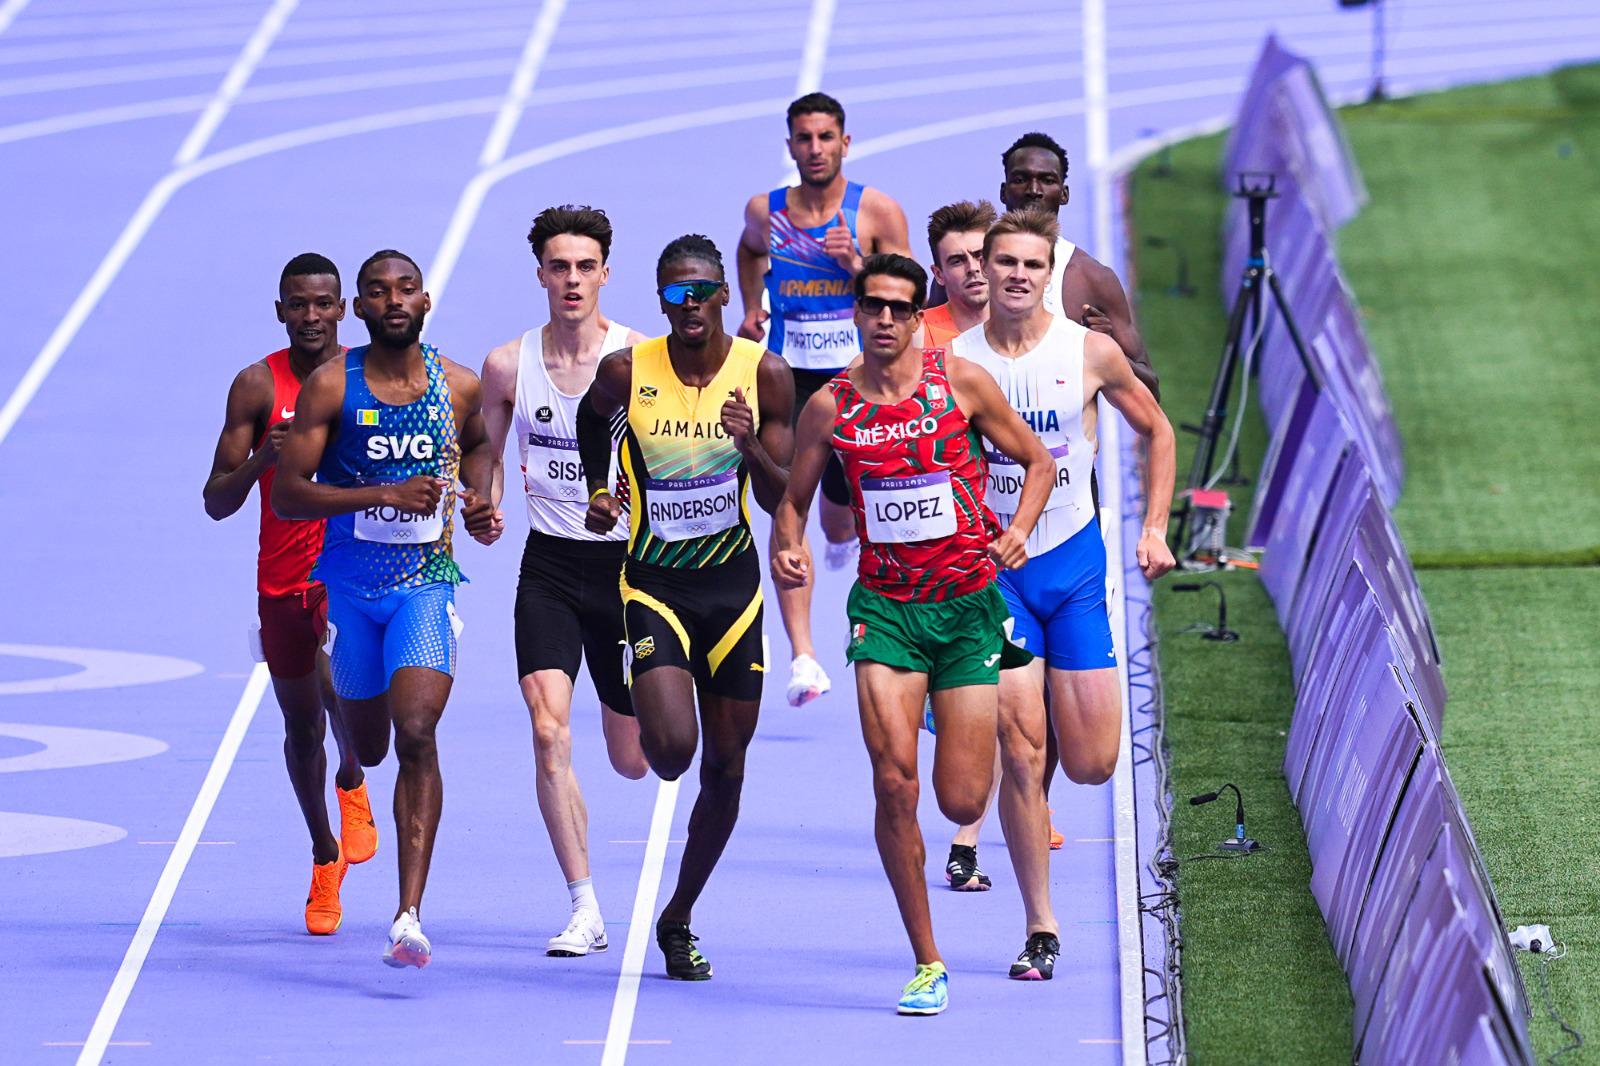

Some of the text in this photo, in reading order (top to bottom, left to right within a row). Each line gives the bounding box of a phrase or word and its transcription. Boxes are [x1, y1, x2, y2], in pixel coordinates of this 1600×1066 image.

[650, 419, 734, 439] JAMAIC
[855, 417, 938, 447] MÉXICO
[367, 434, 433, 460] SVG
[548, 439, 569, 448] PARIS
[694, 478, 716, 487] 2024
[905, 479, 927, 487] 2024
[650, 490, 736, 522] ANDERSON
[875, 497, 943, 522] LOPEZ
